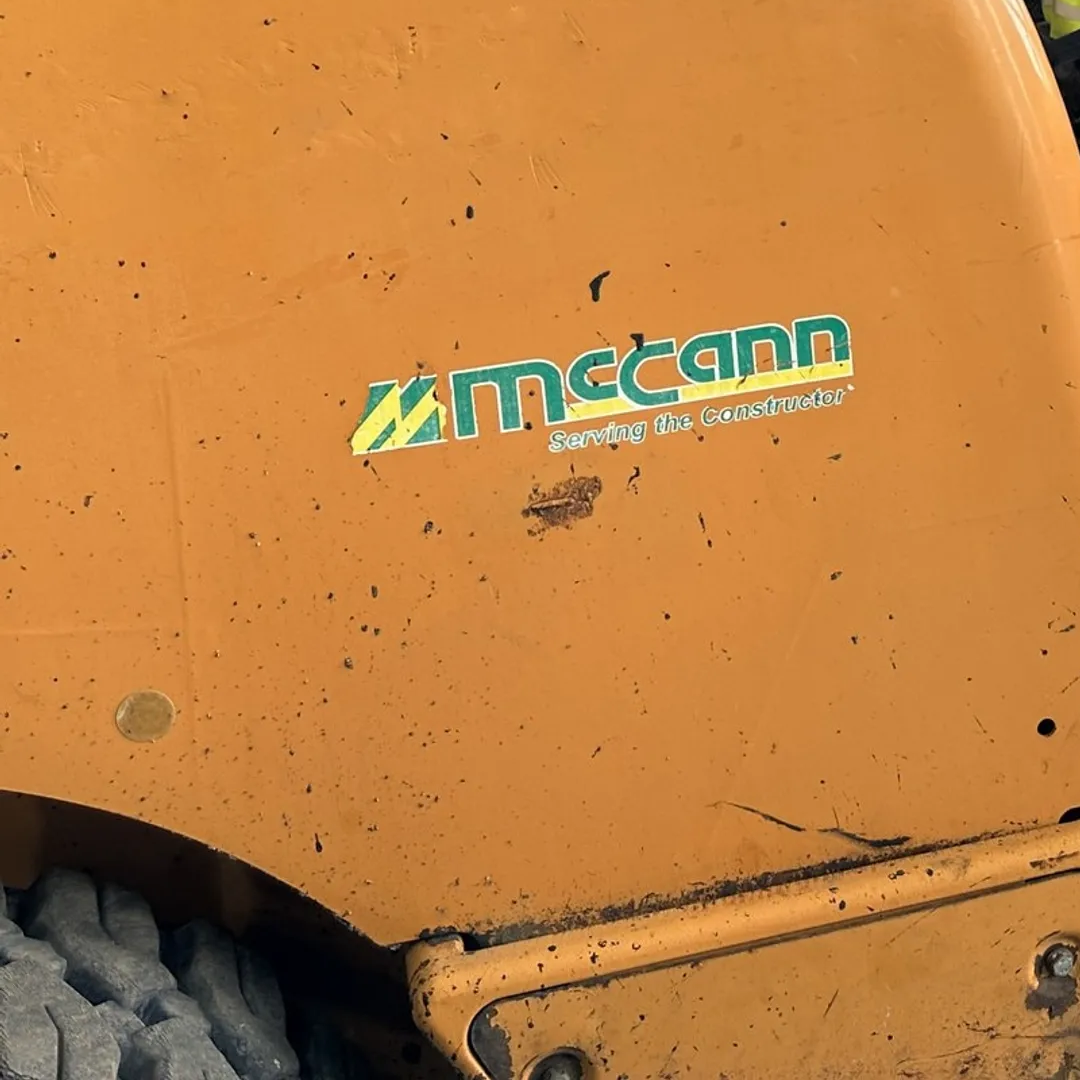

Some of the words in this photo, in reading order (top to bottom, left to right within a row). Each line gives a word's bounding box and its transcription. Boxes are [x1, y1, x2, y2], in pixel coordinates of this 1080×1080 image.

[549, 420, 646, 453] Serving
[654, 411, 693, 434] the
[702, 388, 846, 427] Constructor
